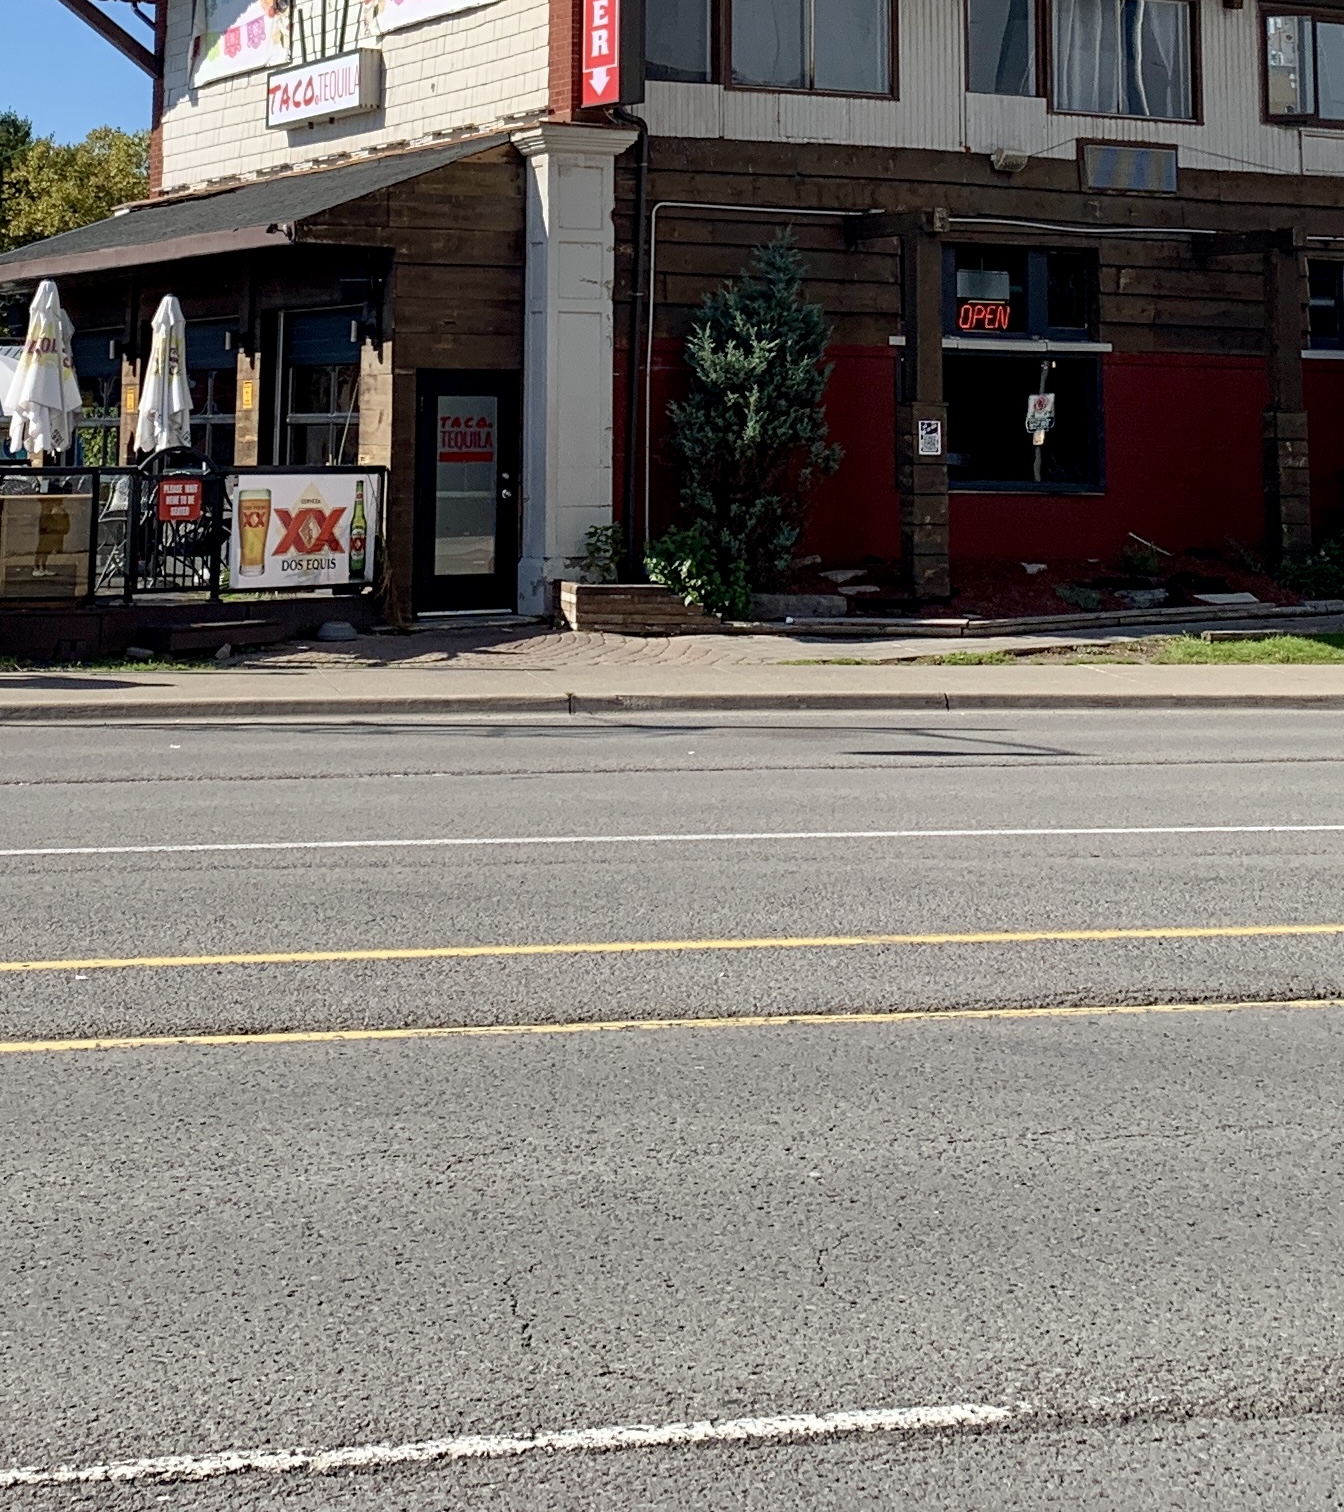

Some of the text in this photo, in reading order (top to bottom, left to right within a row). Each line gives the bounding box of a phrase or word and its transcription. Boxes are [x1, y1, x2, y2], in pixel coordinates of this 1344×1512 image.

[268, 65, 361, 115] TACO TEQUILA
[959, 304, 1010, 330] OPEN
[440, 416, 488, 429] TACO
[440, 430, 493, 450] TEQUILA
[271, 506, 347, 556] XX
[282, 558, 336, 572] DOS EQUIS
